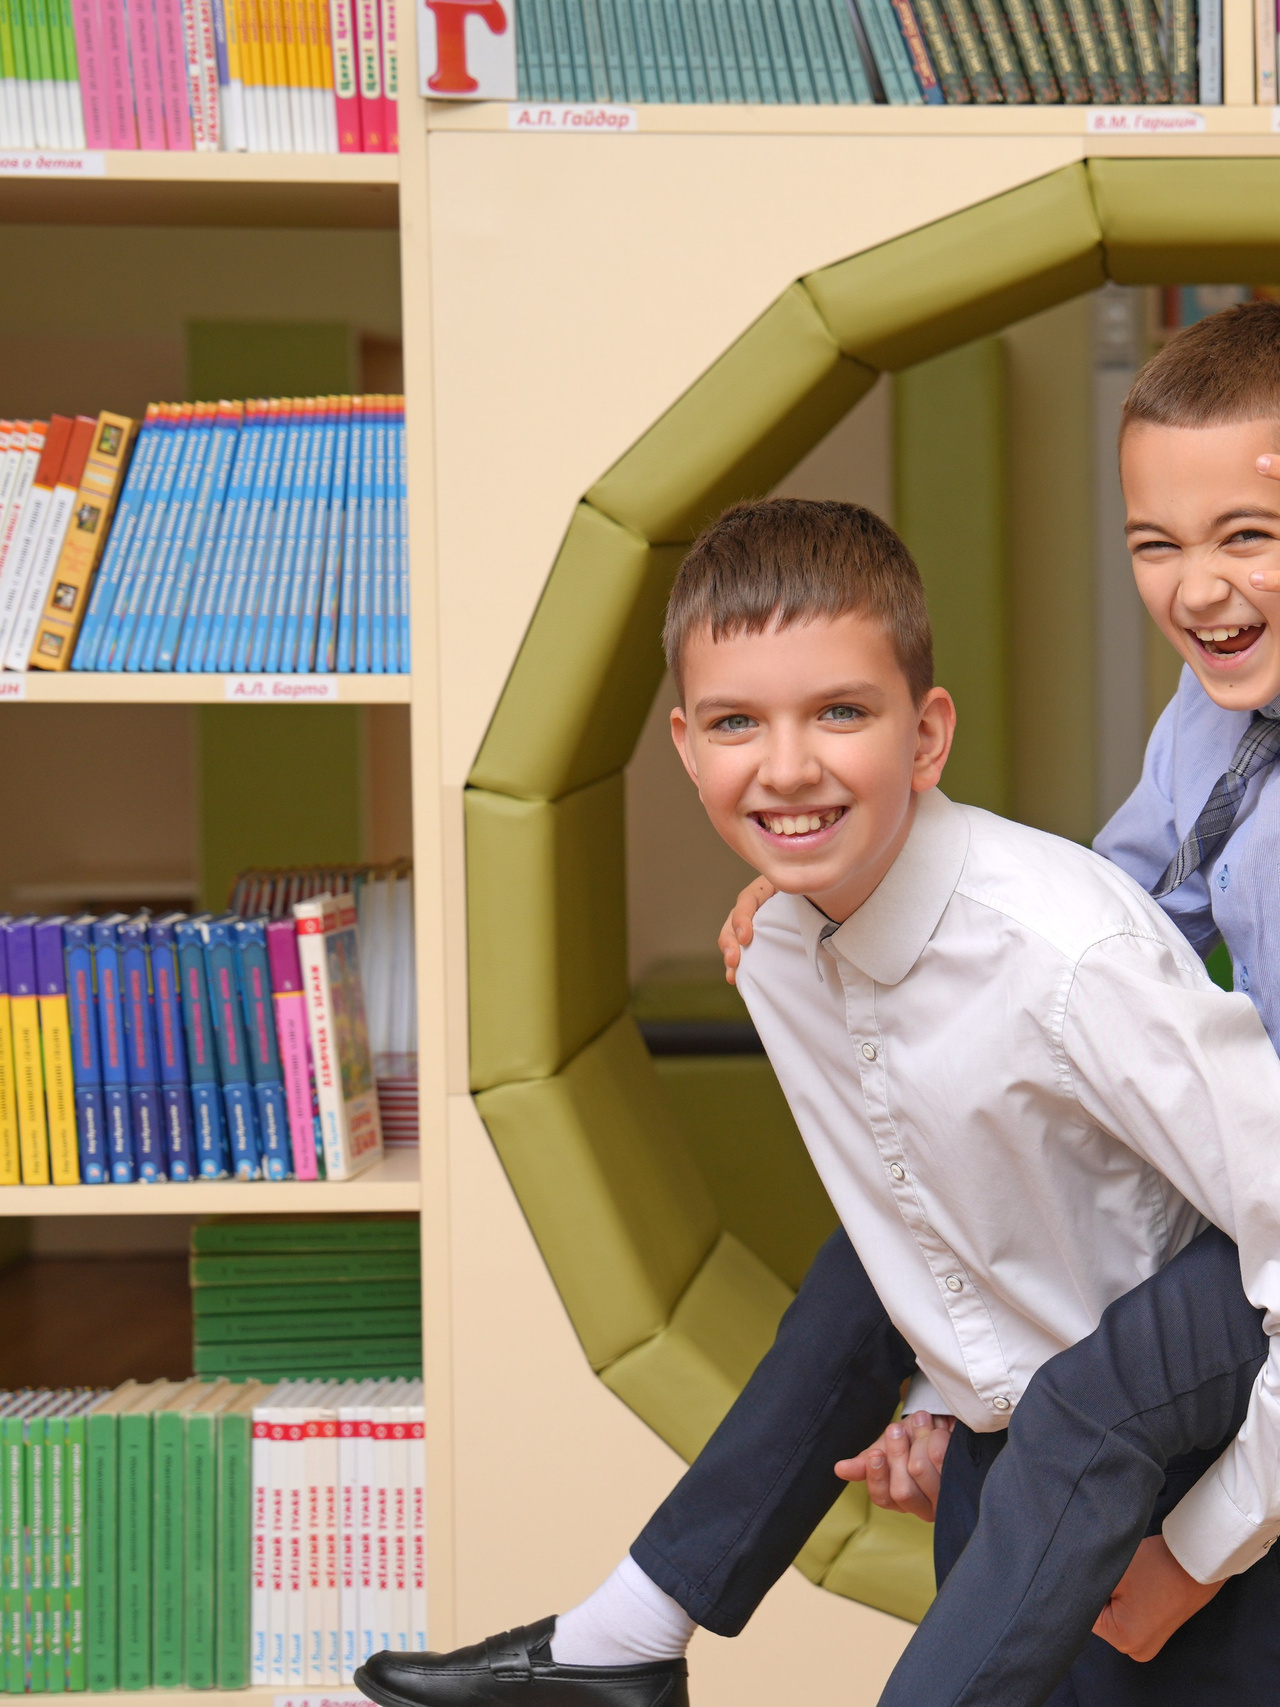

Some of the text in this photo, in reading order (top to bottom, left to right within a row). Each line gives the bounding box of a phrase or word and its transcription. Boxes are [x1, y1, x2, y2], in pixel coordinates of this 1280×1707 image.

[426, 0, 507, 94] Г
[517, 109, 630, 130] А.П. Гайдар
[1094, 115, 1197, 131] В.М. Гаршин
[23, 159, 32, 169] о
[36, 155, 83, 169] детях
[234, 682, 329, 698] А.Л. Барто
